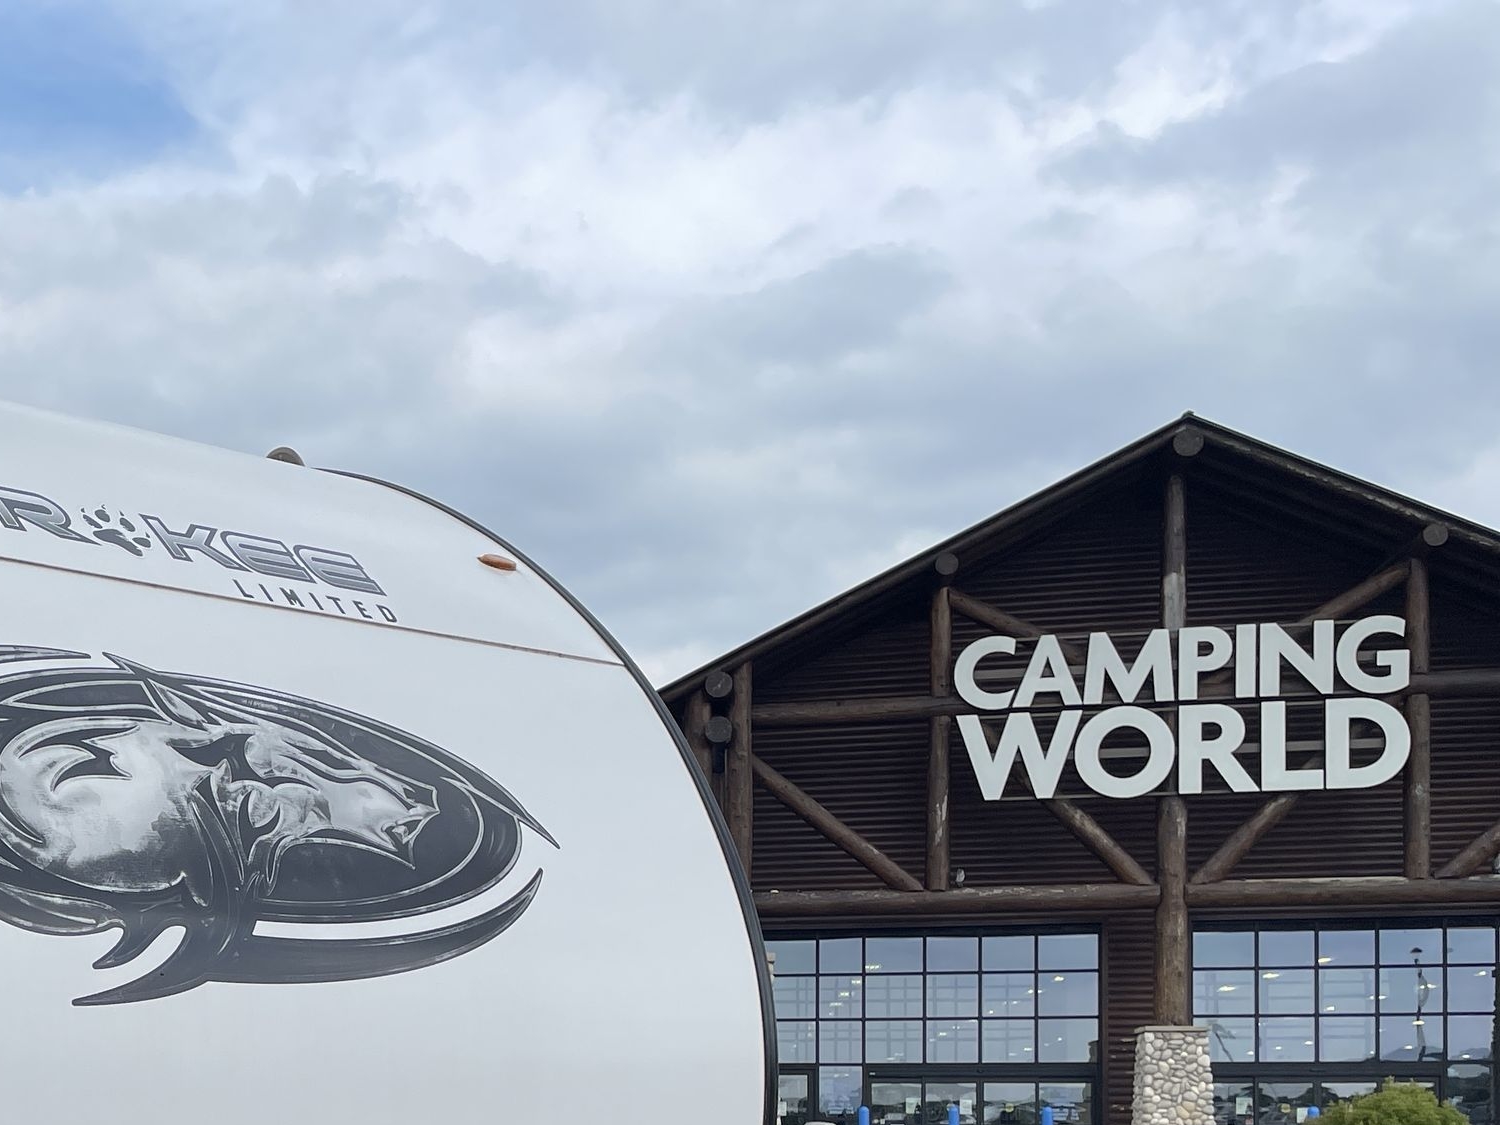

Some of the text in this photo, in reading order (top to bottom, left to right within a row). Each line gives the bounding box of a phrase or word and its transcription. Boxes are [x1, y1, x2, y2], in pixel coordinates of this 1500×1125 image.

[231, 578, 398, 623] LIMITED
[953, 614, 1411, 711] CAMPING
[955, 697, 1412, 801] WORLD
